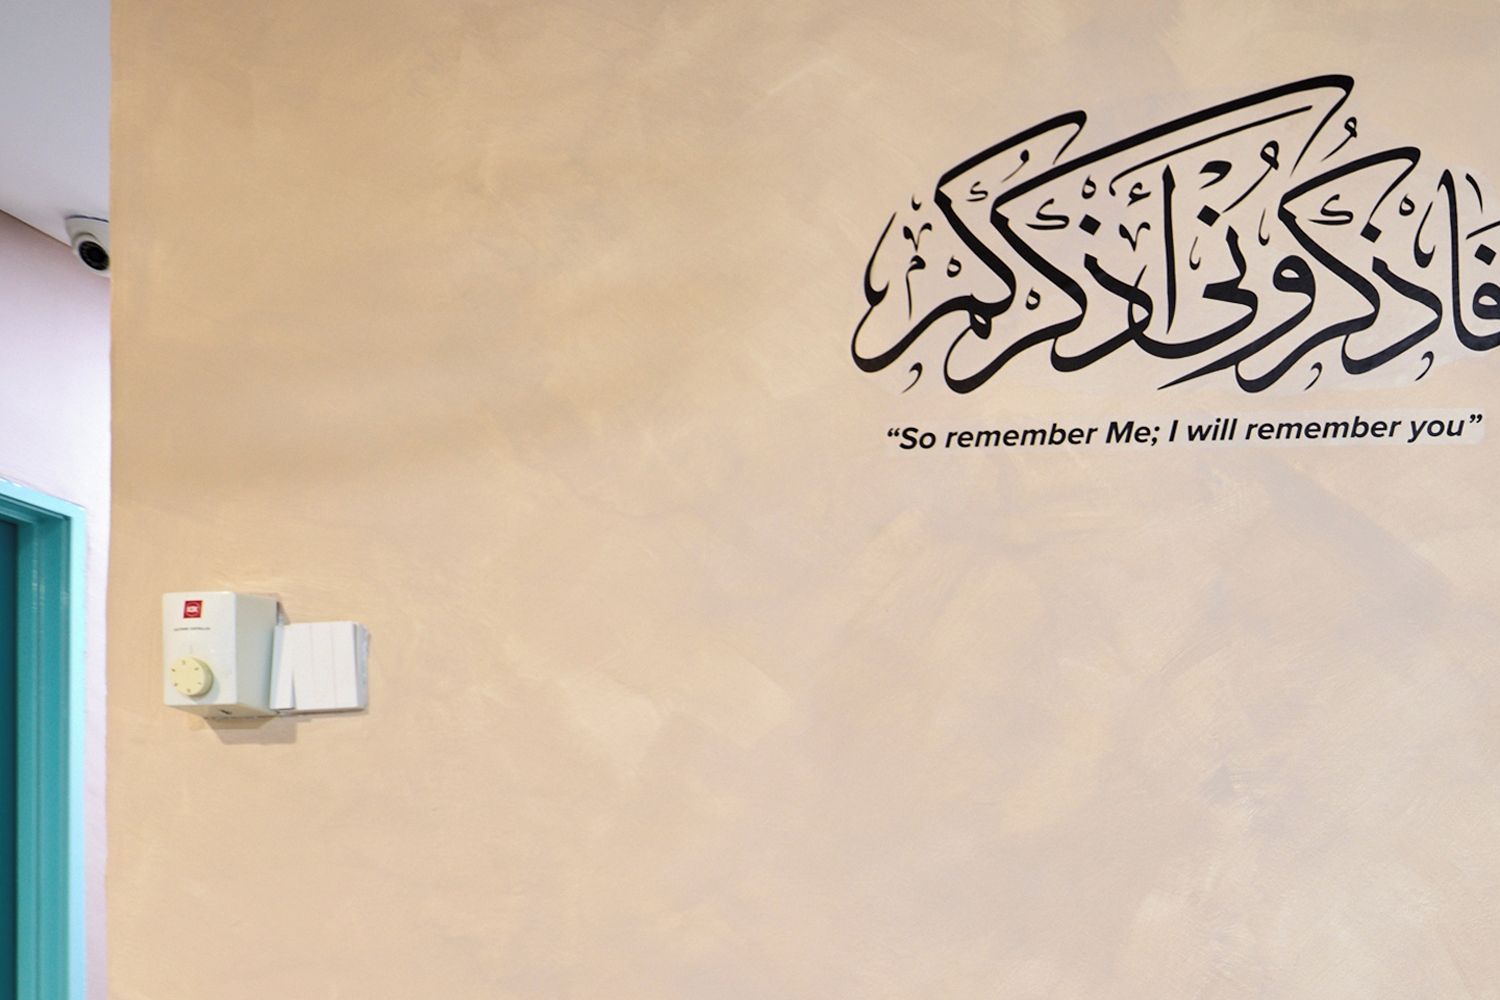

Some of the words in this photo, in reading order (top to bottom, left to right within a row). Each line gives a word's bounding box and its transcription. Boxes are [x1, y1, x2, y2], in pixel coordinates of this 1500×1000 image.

[946, 423, 1098, 448] remember
[1106, 421, 1160, 446] Me;
[1169, 420, 1178, 442] I
[1188, 418, 1237, 441] will
[1245, 416, 1401, 440] remember
